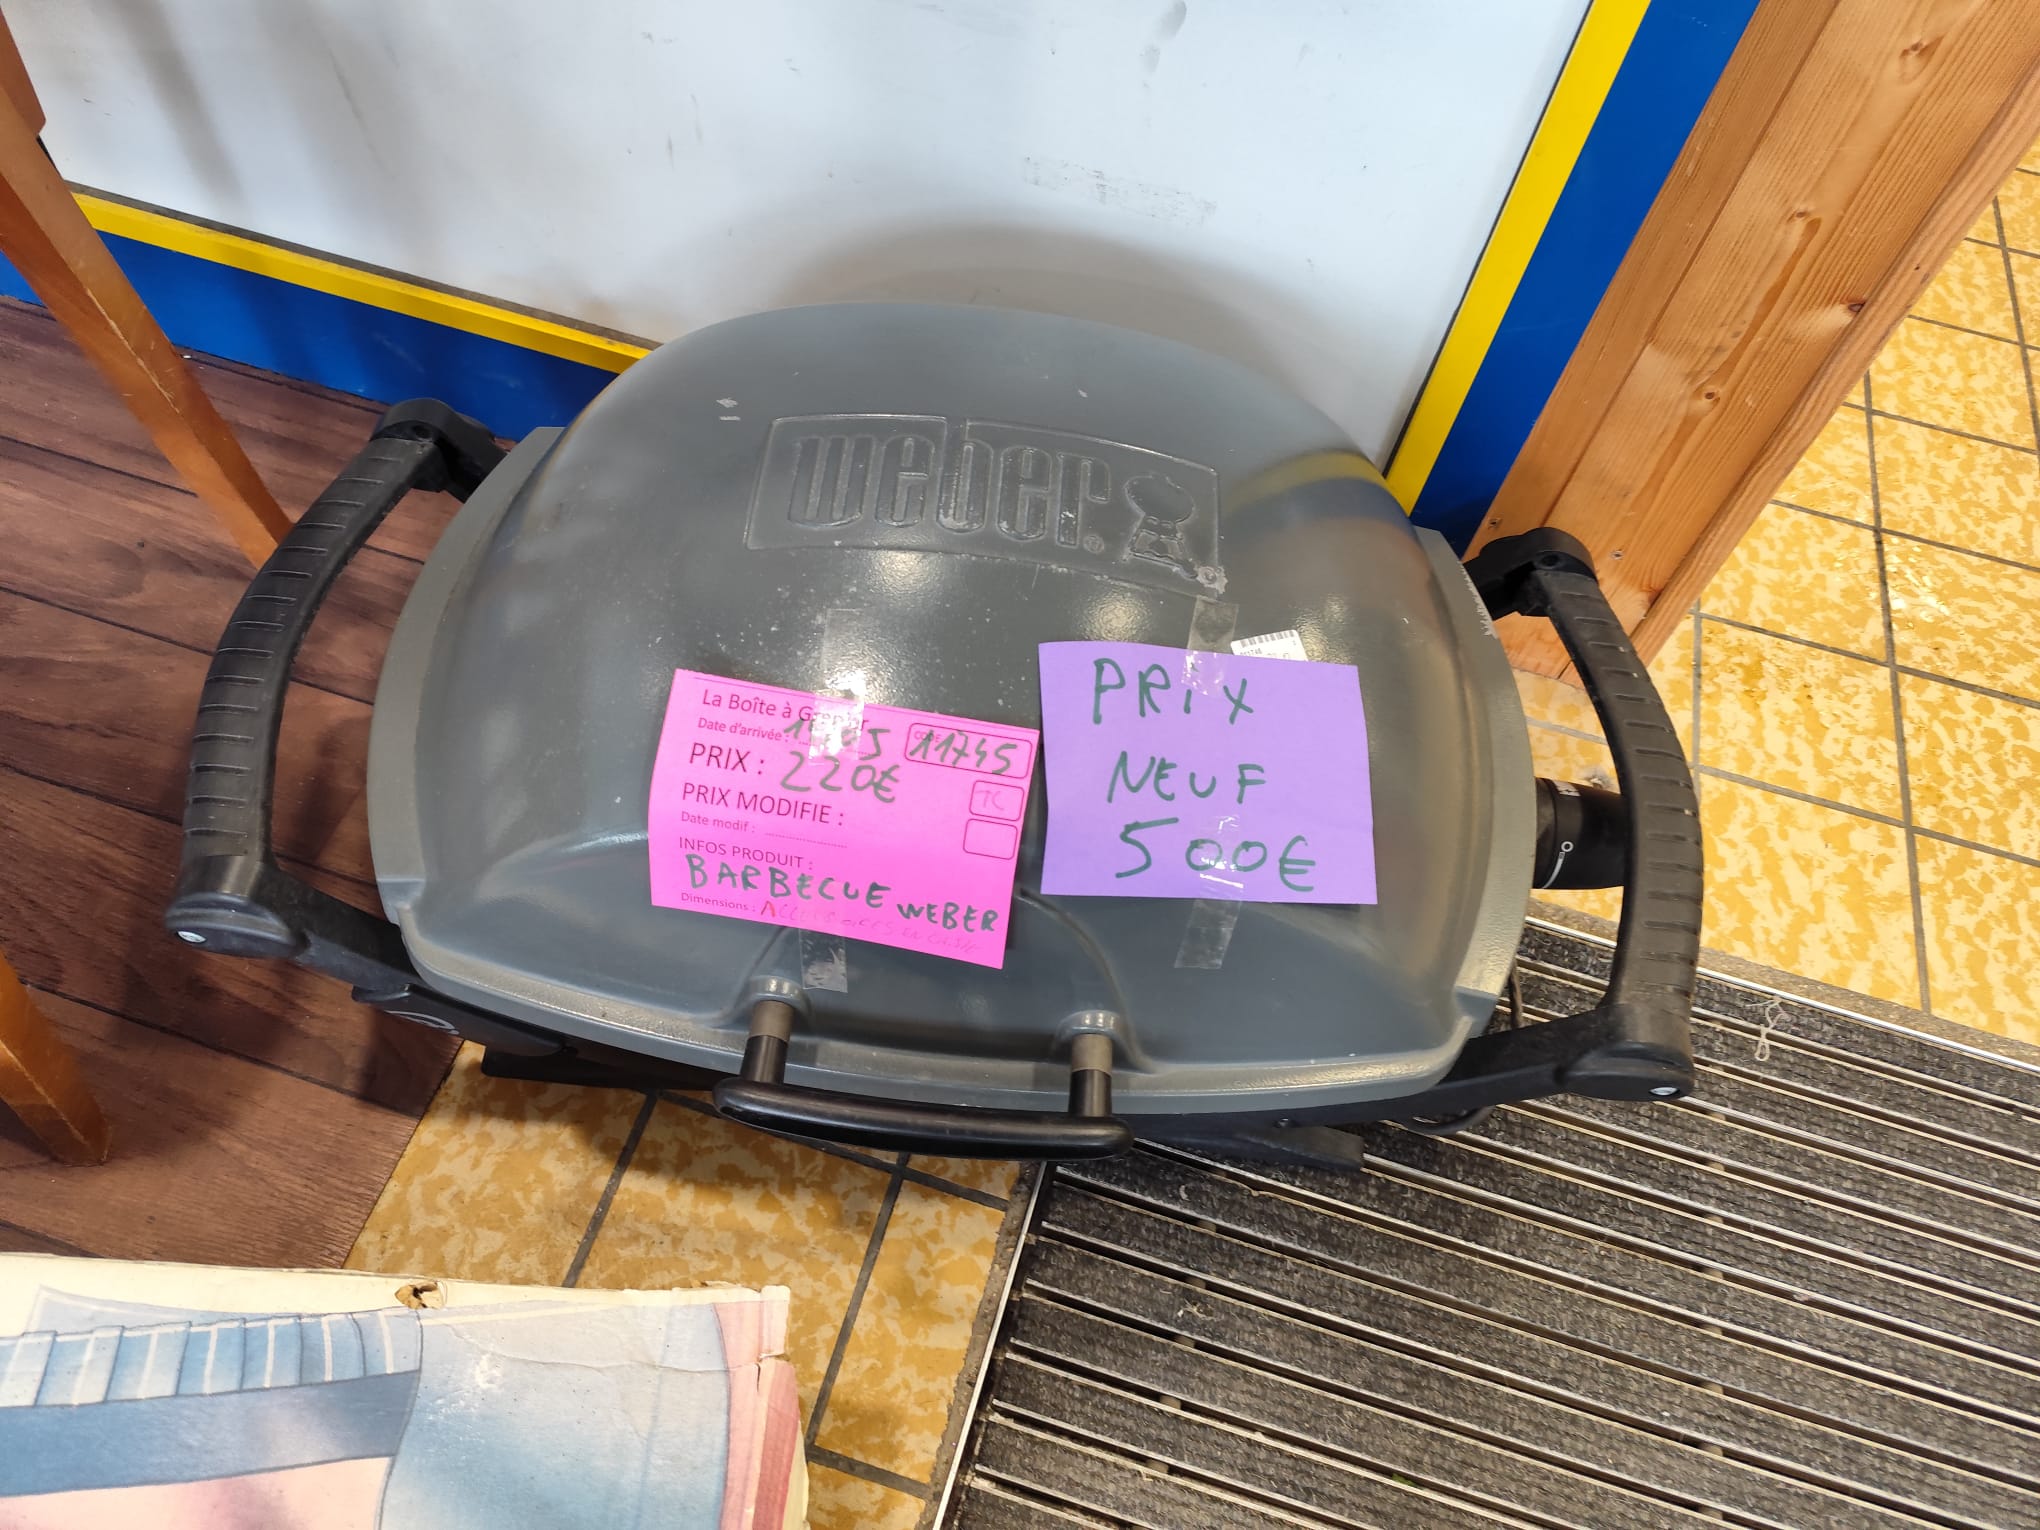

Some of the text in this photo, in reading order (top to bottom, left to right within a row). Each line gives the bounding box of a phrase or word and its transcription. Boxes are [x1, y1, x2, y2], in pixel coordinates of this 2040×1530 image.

[702, 689, 722, 708] La
[728, 692, 776, 717] Boîte
[782, 701, 792, 719] à
[697, 717, 727, 733] Date
[729, 721, 782, 742] d'arrivée
[689, 742, 751, 773] PRIX
[909, 729, 1018, 775] 11745
[780, 750, 901, 803] 220€
[1107, 750, 1267, 805] NEUF
[681, 811, 709, 826] Date
[713, 818, 749, 832] modif
[682, 782, 731, 808] PRIX
[737, 791, 832, 824] MODIFIE
[679, 836, 727, 856] INFOS
[732, 845, 804, 869] PRODUIT
[1115, 817, 1316, 892] 500€
[681, 891, 748, 912] Dimensions
[685, 853, 999, 933] BARBECUE WEBER
